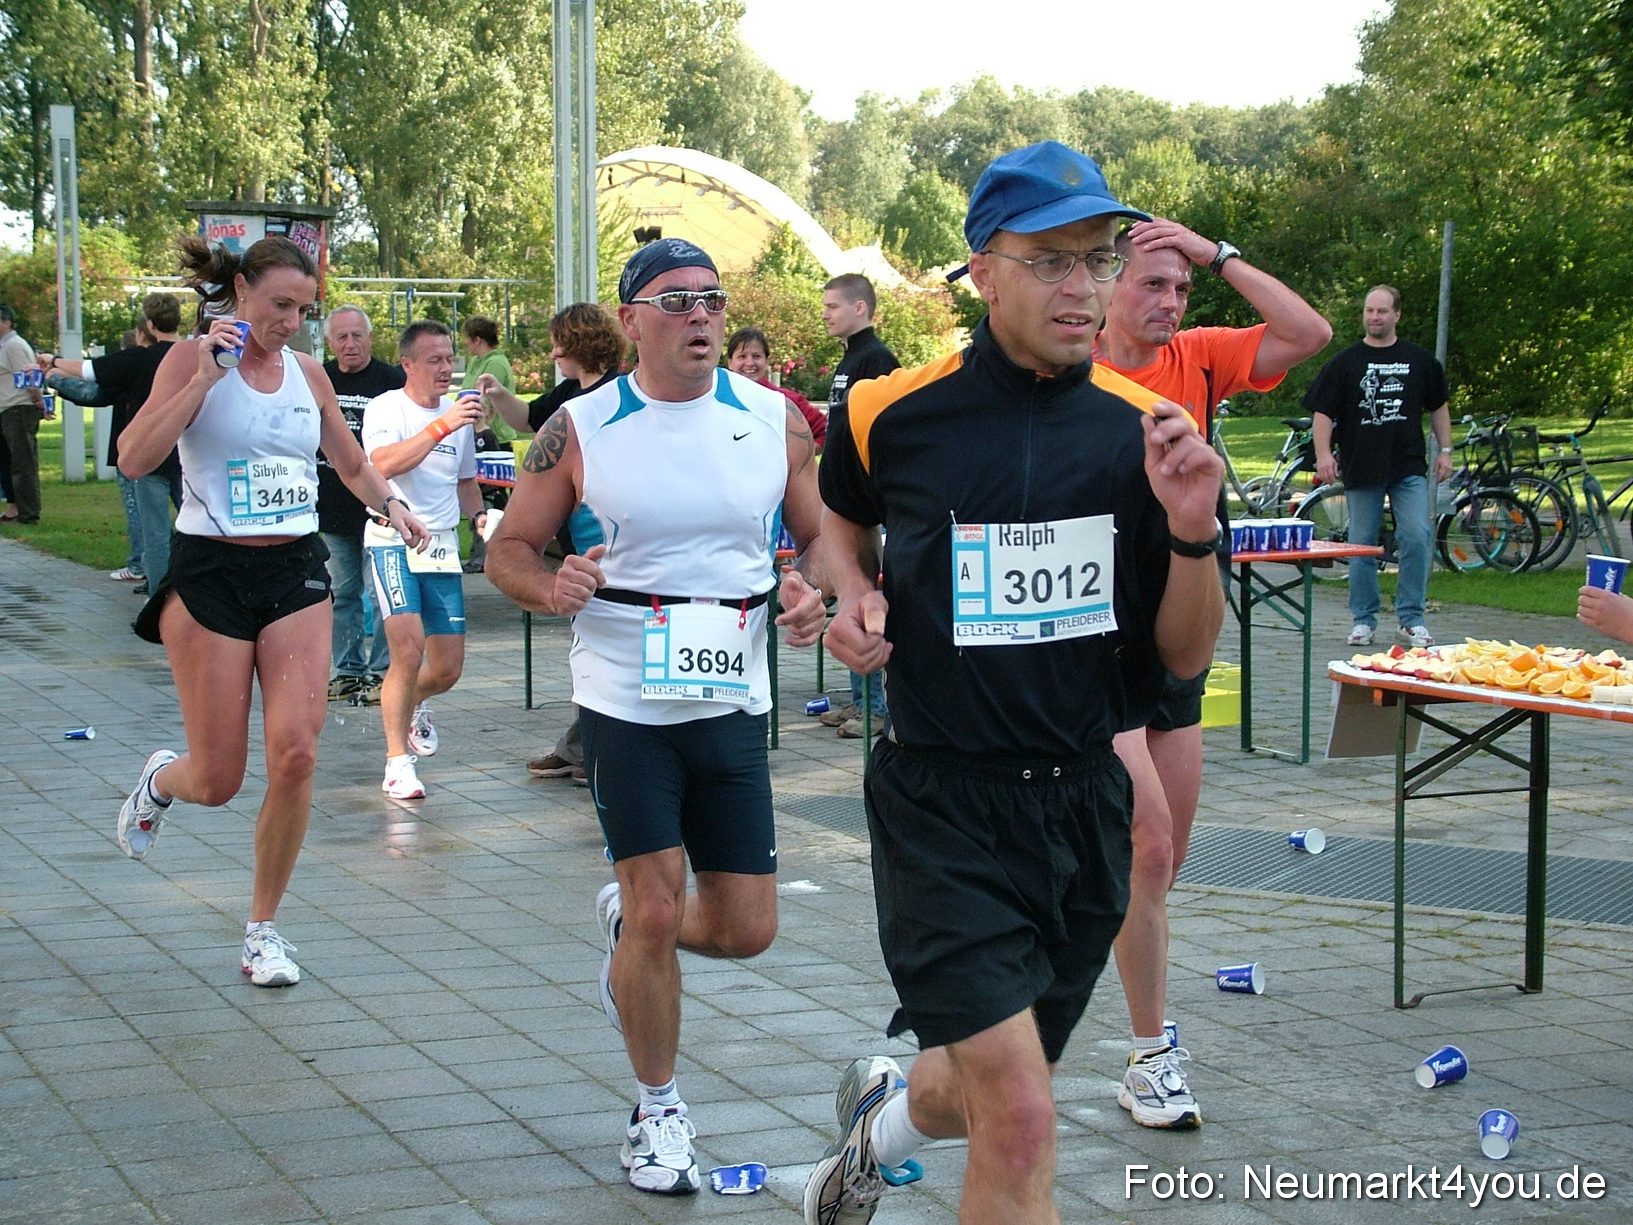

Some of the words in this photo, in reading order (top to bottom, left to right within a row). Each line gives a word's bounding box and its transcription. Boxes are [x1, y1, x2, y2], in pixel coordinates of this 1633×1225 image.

[252, 463, 289, 479] Sibylle
[233, 486, 240, 497] A
[257, 486, 309, 508] 3418
[999, 523, 1055, 551] Ralph
[960, 562, 971, 580] A
[1004, 561, 1101, 605] 3012
[1056, 611, 1112, 630] PFLEIDERER
[956, 623, 1019, 637] BOCK
[678, 647, 745, 677] 3694
[714, 687, 749, 699] PFLEIDERER
